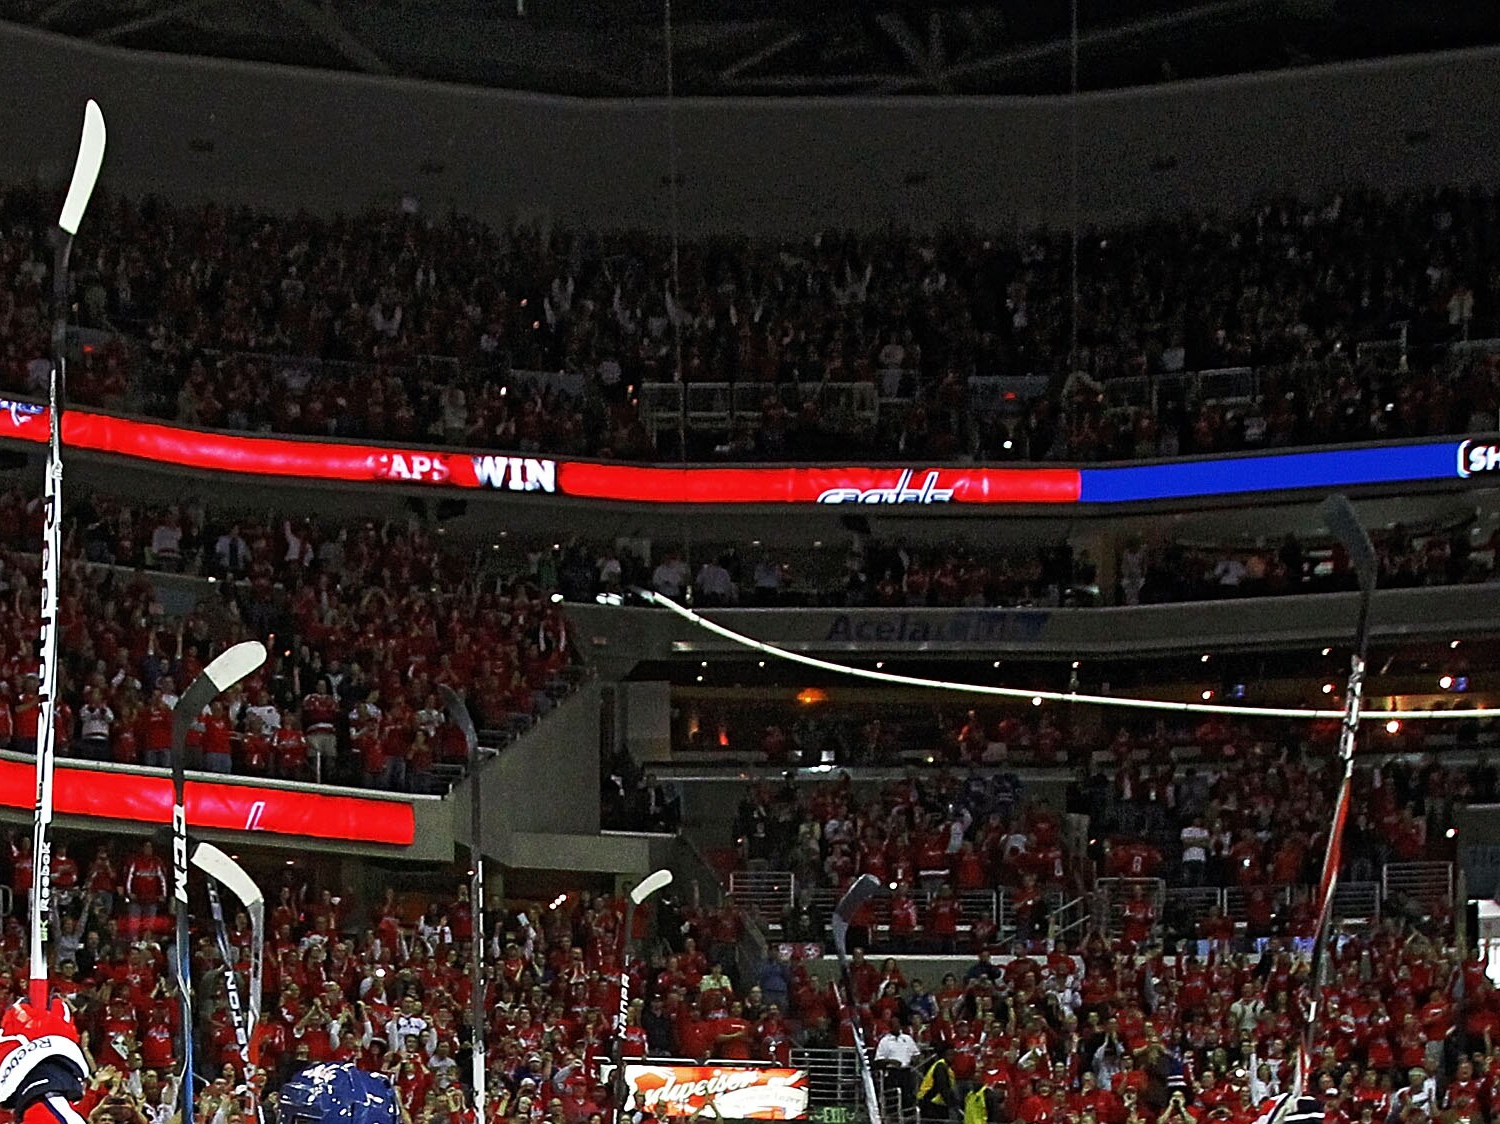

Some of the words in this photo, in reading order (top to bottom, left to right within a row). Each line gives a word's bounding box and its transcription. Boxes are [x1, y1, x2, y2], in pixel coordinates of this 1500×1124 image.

[473, 456, 556, 492] WIN
[173, 804, 188, 904] CCM
[823, 1106, 847, 1124] EXIT
